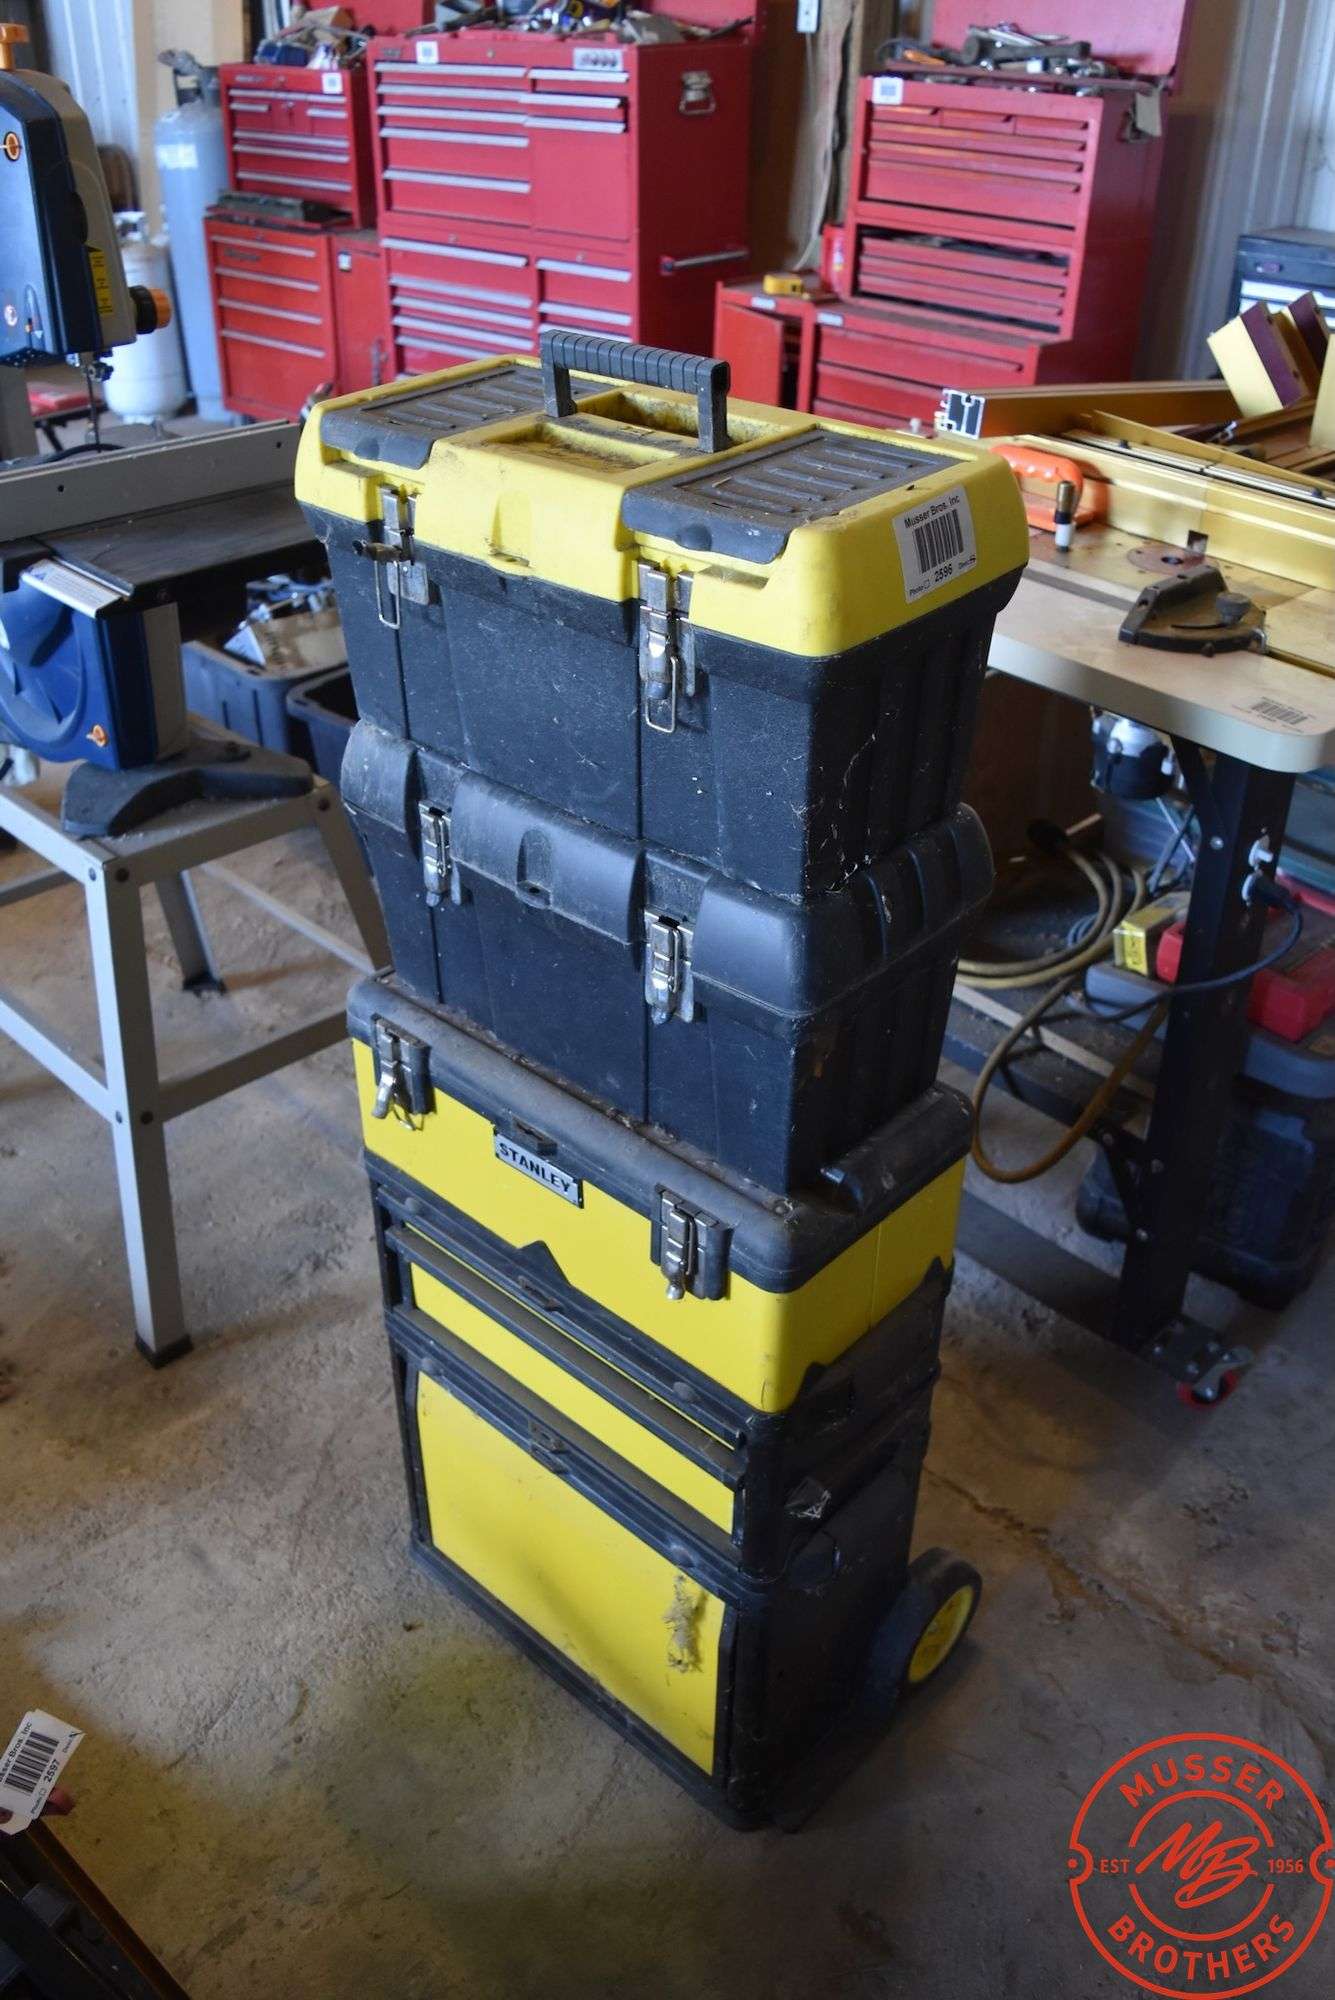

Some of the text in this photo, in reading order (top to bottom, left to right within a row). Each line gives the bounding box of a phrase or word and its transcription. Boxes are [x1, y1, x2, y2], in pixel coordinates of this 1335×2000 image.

[904, 510, 930, 529] Musser
[934, 563, 953, 582] 2596
[499, 1142, 571, 1193] STANLEY
[43, 1759, 59, 1783] 2597
